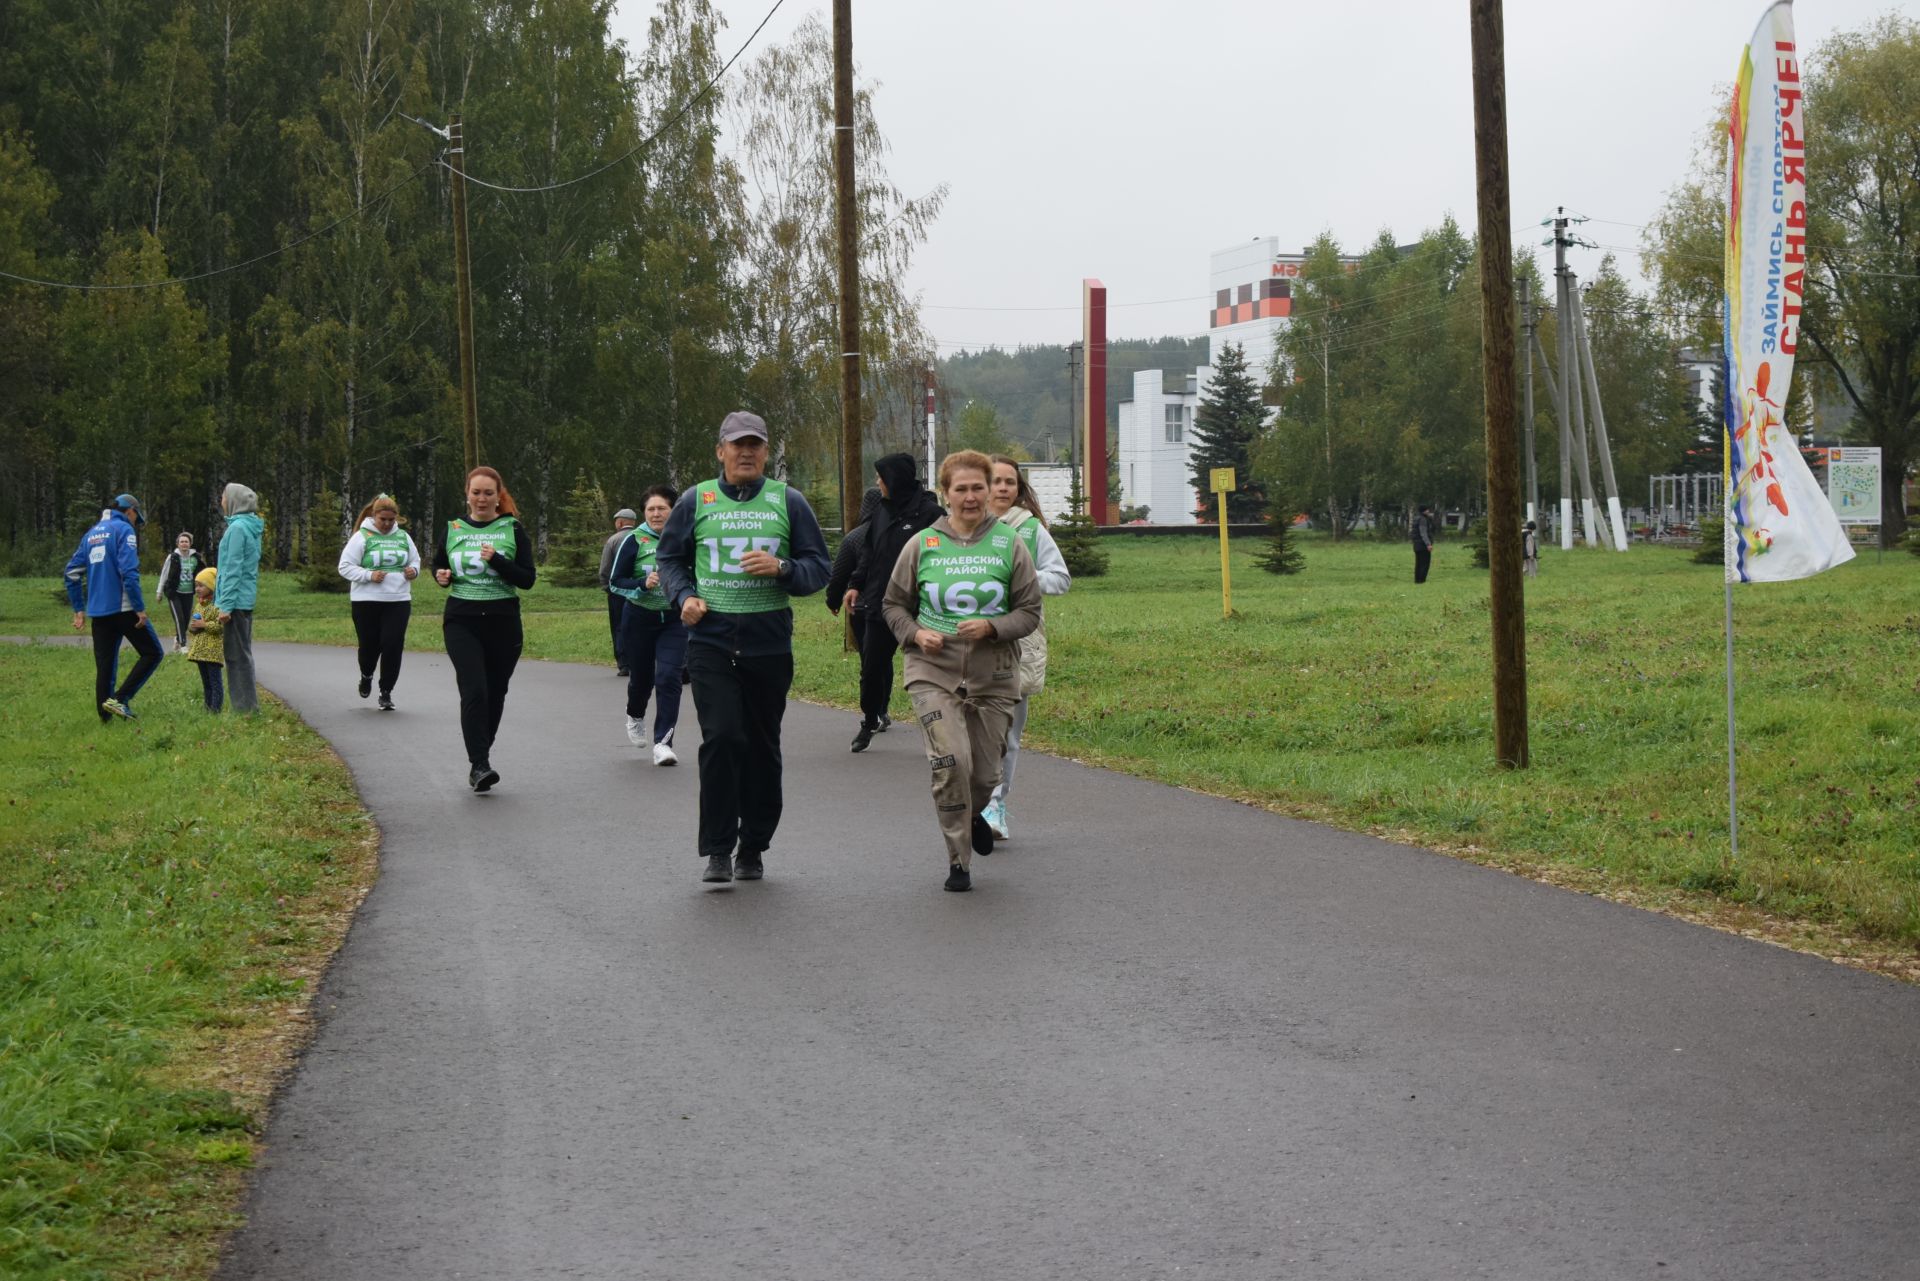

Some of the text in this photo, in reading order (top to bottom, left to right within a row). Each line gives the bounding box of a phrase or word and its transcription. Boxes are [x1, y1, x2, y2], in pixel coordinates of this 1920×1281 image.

[1775, 41, 1807, 355] СТАНЬ ЯРЧЕ!
[1761, 84, 1784, 355] ЗАЙМИСЬ СПОРТОМ
[721, 520, 762, 530] РАЙОН
[369, 549, 408, 568] 157
[930, 554, 1004, 566] ТУКАЕВСКИЙ
[945, 565, 987, 576] РАЙОН
[924, 580, 1005, 616] 162
